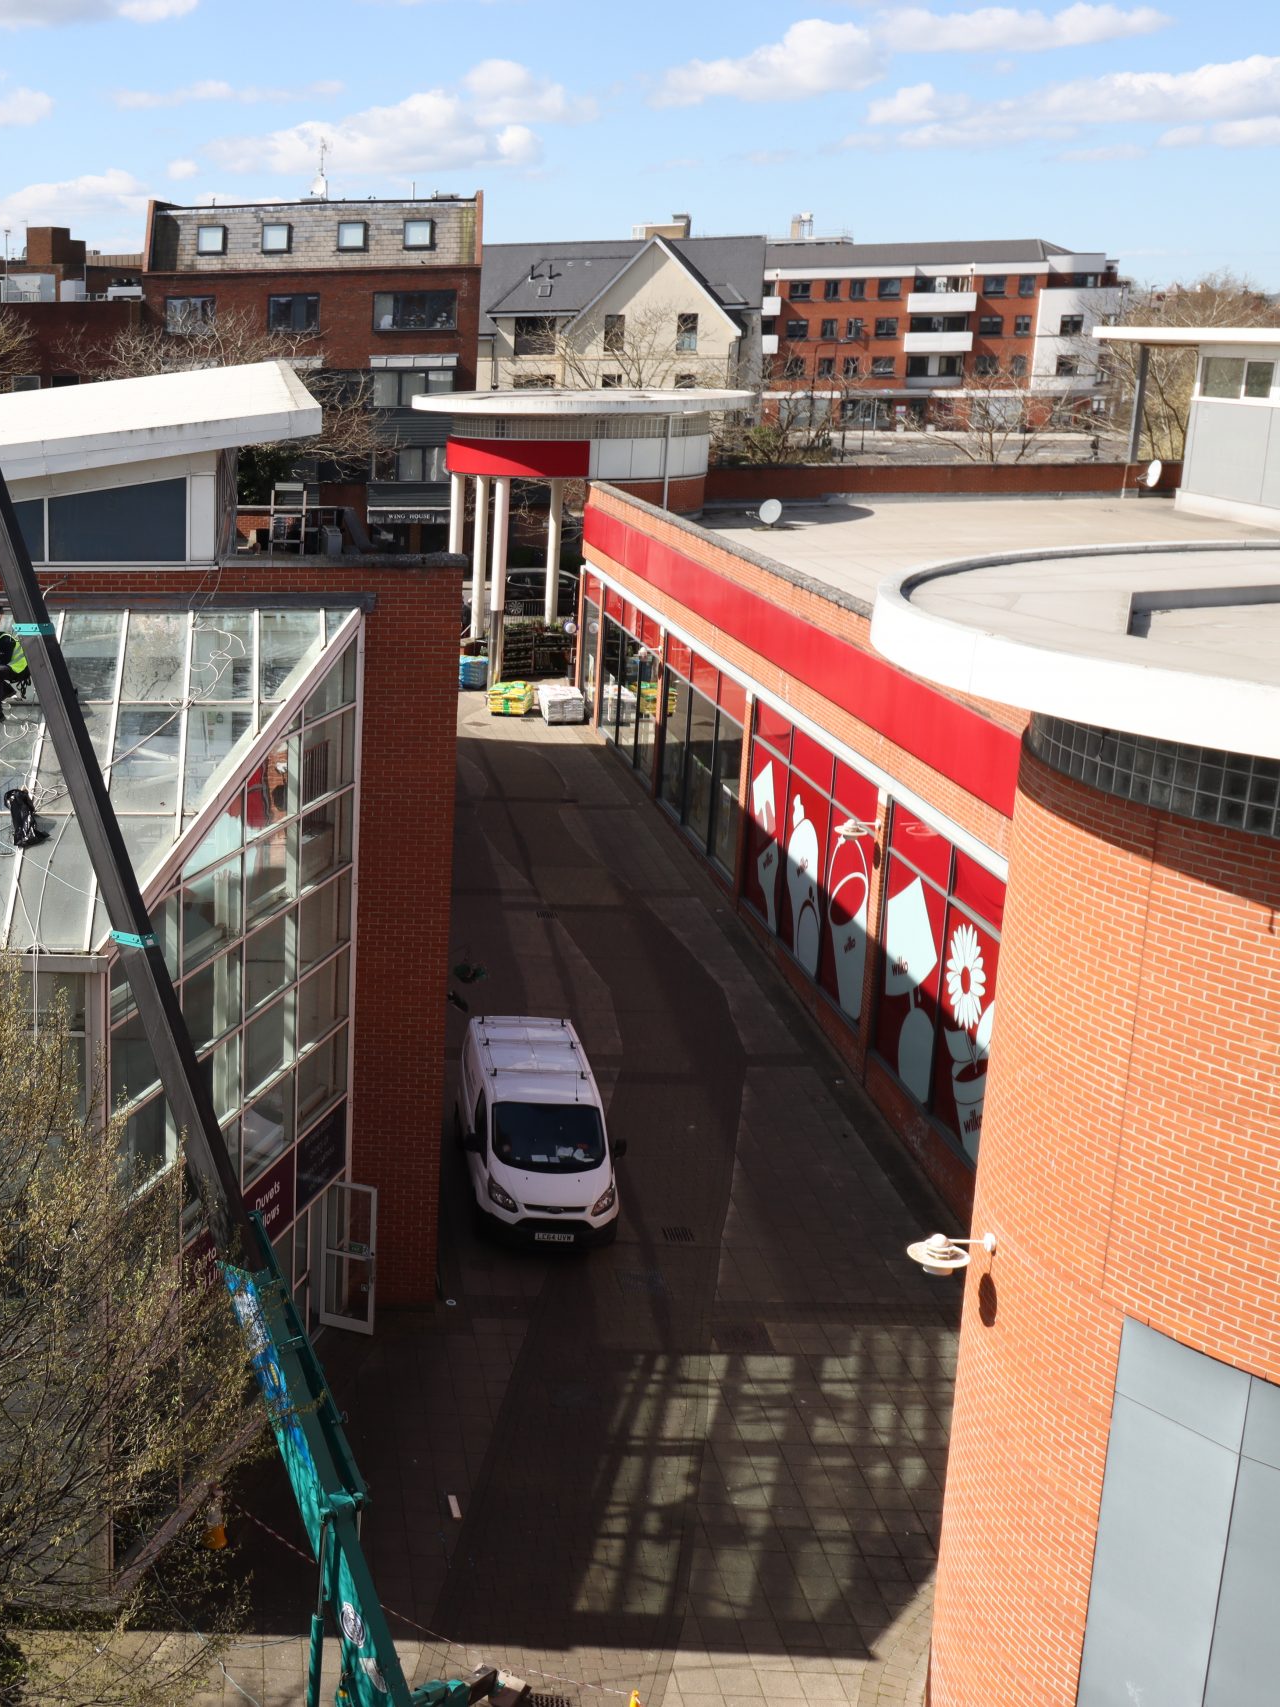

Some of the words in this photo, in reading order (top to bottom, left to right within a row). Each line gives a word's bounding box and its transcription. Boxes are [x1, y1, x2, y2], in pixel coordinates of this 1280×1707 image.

[892, 952, 908, 976] wilko
[255, 1181, 280, 1211] Duvets
[262, 1204, 280, 1228] llows
